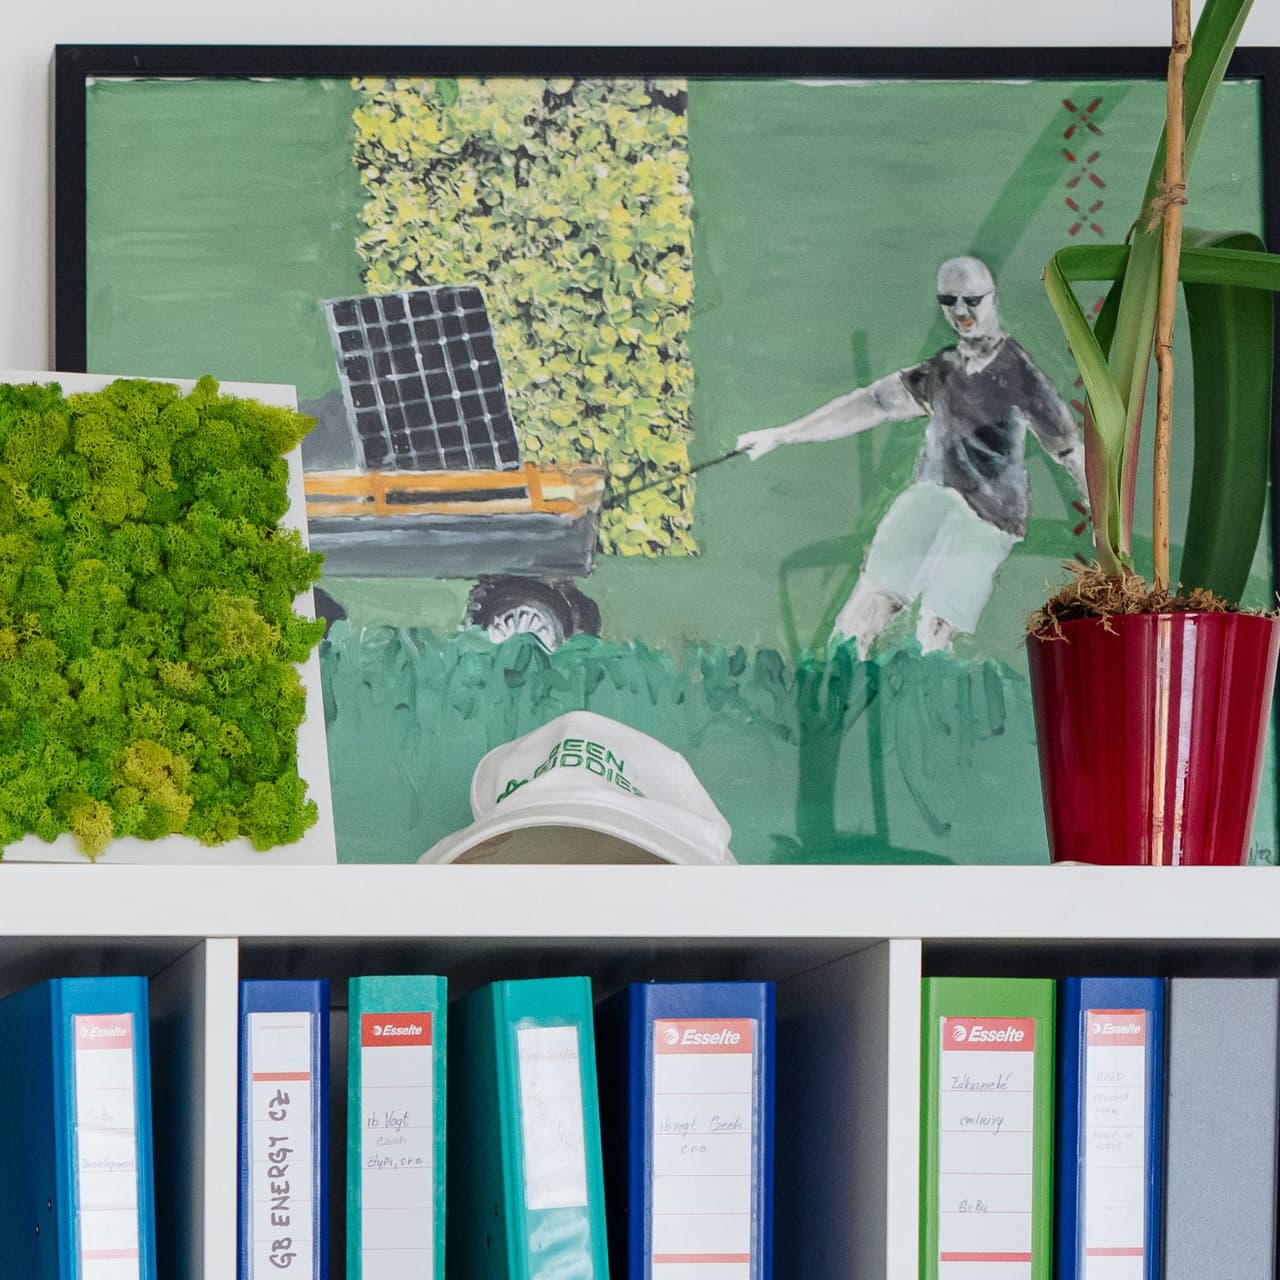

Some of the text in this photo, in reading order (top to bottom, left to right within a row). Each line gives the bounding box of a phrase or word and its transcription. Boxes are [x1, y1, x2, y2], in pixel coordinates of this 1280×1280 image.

[549, 738, 624, 773] EEN
[90, 1025, 128, 1038] Esselte
[383, 1024, 423, 1037] Esselte
[681, 1028, 741, 1046] Esselte
[968, 1025, 1025, 1043] Esselte
[1102, 1023, 1141, 1034] Esselte
[385, 1109, 409, 1132] Vogt
[267, 1088, 297, 1269] GB ENERGY CZ
